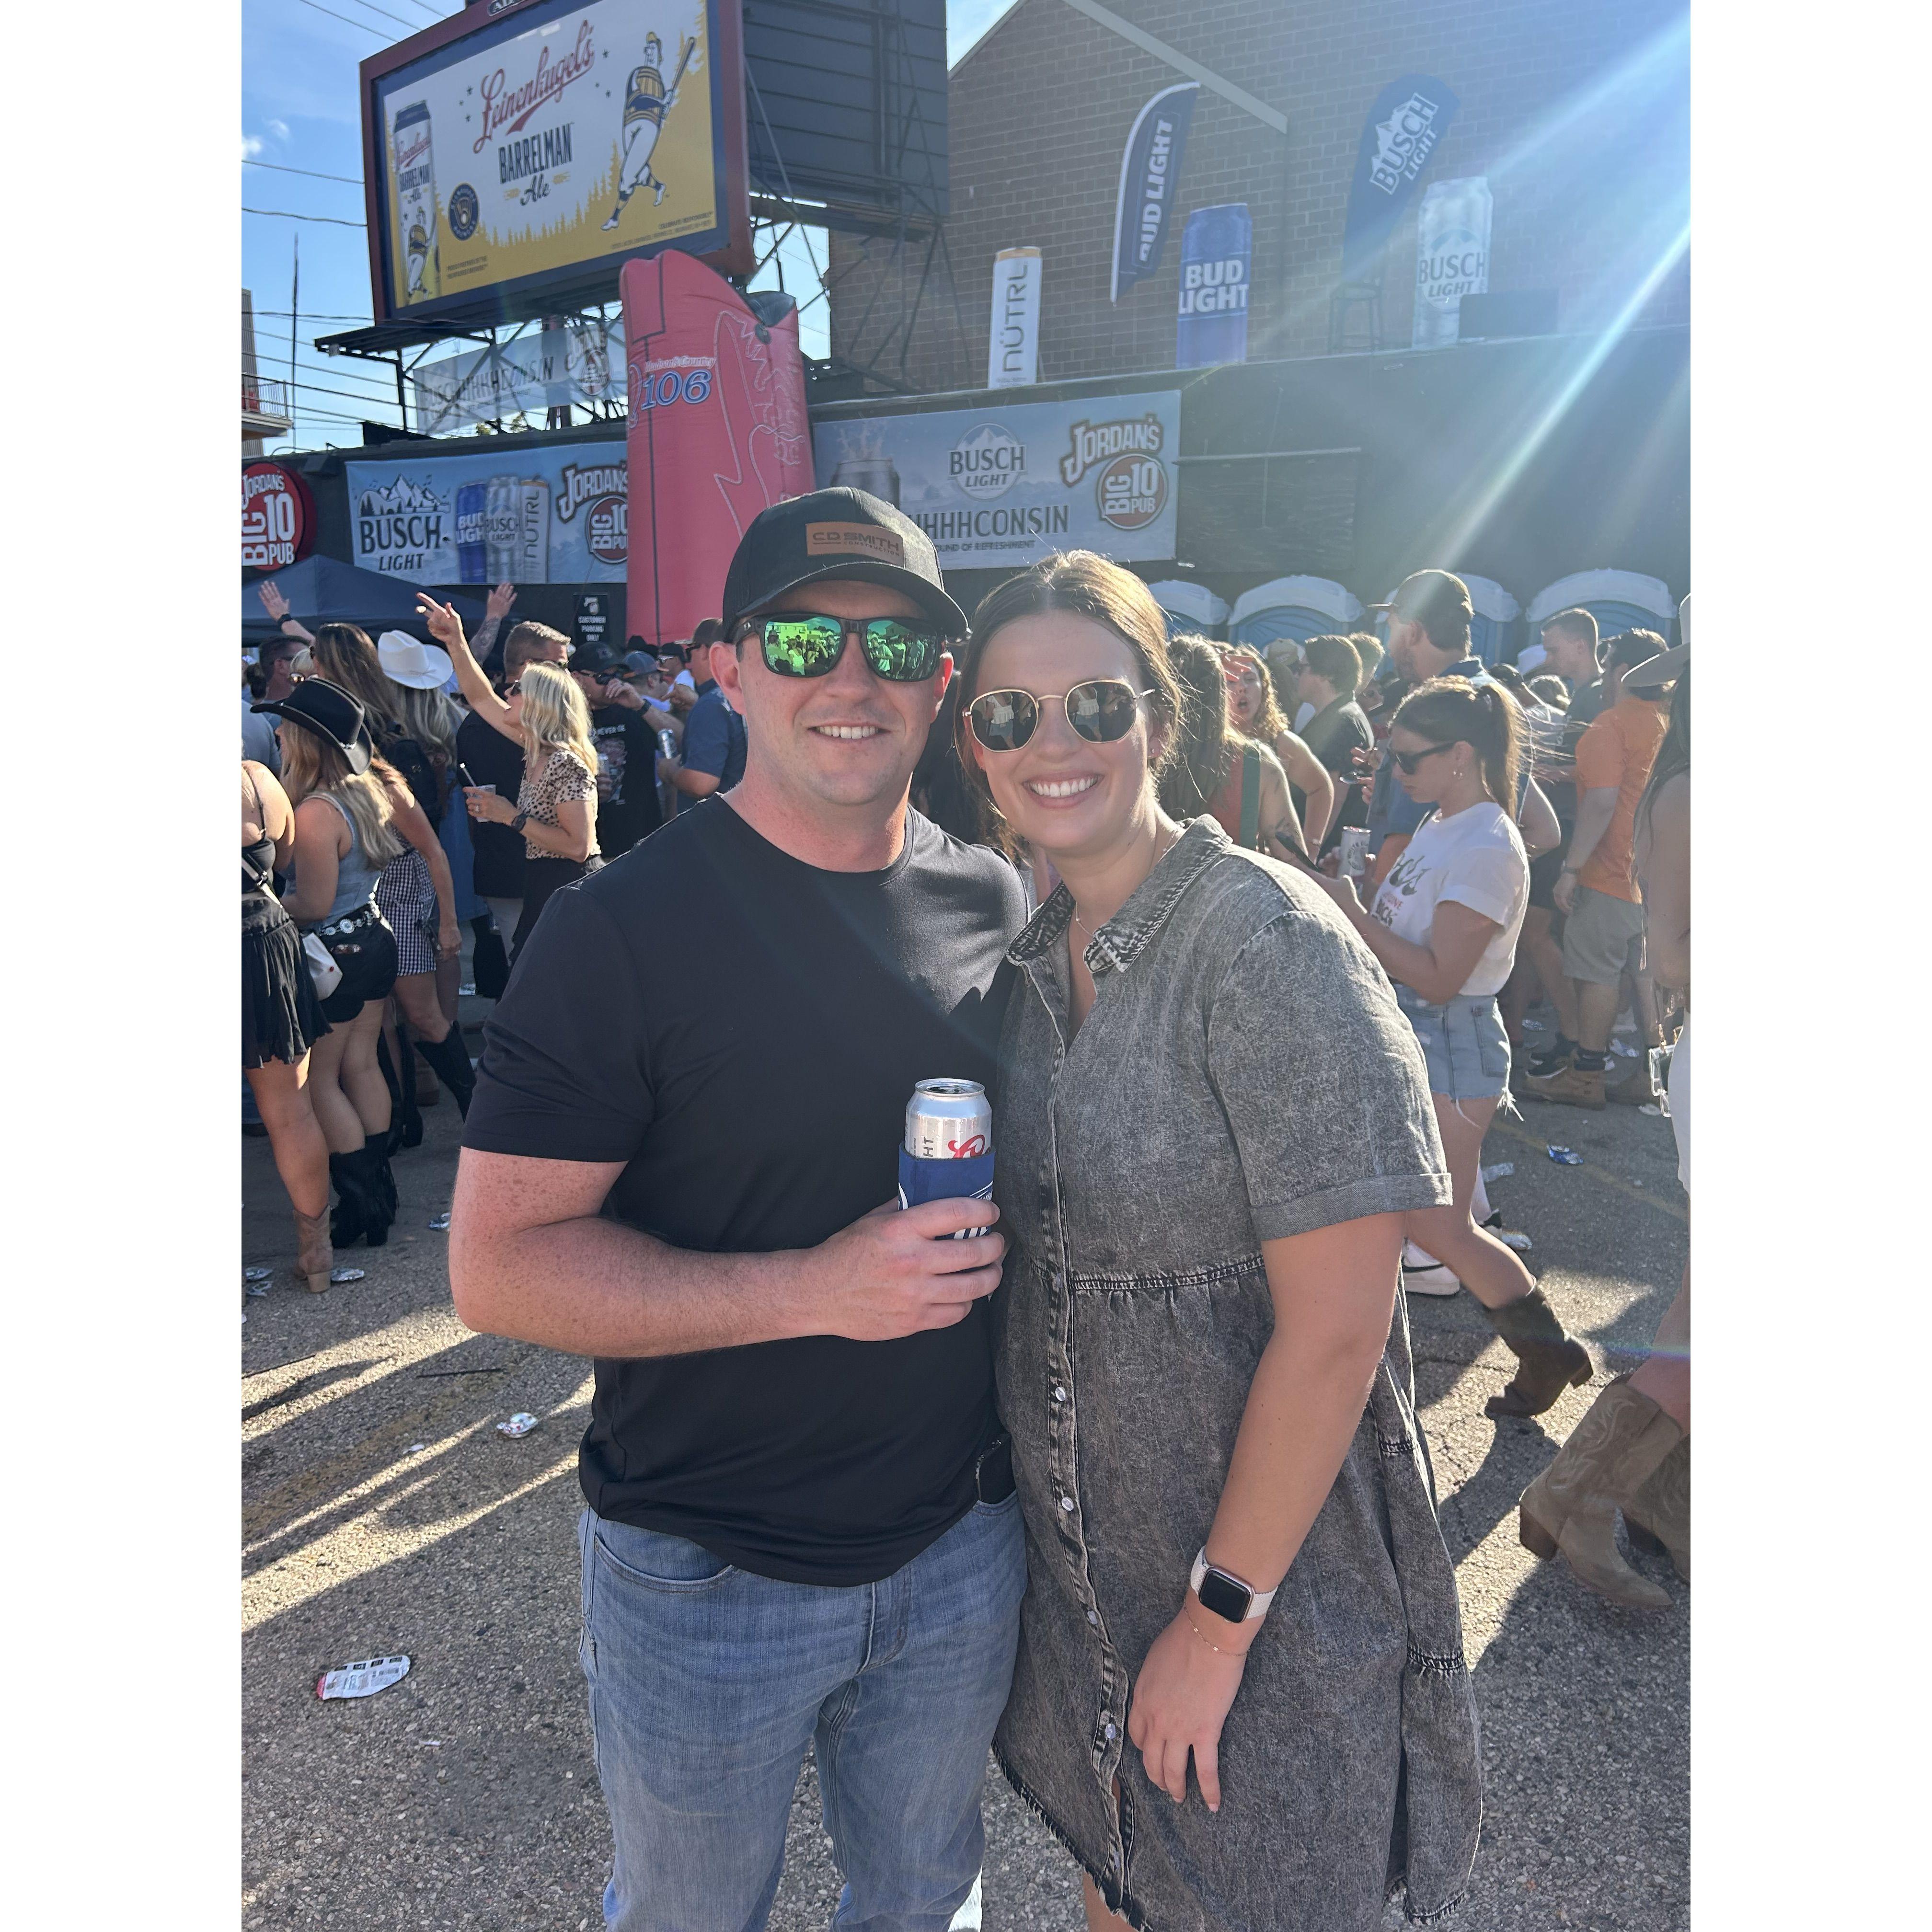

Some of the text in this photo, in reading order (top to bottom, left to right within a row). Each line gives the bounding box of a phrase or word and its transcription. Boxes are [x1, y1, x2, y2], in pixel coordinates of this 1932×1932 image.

[473, 19, 595, 153] Leinenkugel's
[498, 123, 573, 184] BARRELMAN
[1371, 94, 1437, 193] BUSCH
[1403, 129, 1437, 181] LIGHT
[1145, 119, 1173, 200] LIGHT
[520, 173, 551, 206] Ale
[1184, 260, 1244, 289] BUD
[1418, 253, 1486, 284] BUSCH
[1179, 284, 1249, 314] LIGHT
[1428, 281, 1474, 298] LIGHT
[950, 446, 1025, 475] BUSCH
[1064, 418, 1160, 483] JORDAN'S
[242, 470, 285, 510] JORDAN'S
[965, 473, 1010, 487] LIGHT
[1104, 461, 1159, 515] BIG 10
[1131, 497, 1156, 514] PUB
[242, 493, 296, 566] BIG 10
[359, 515, 442, 554] BUSCH
[456, 528, 485, 544] LIGH
[591, 514, 613, 549] BIG
[613, 536, 628, 549] PU
[844, 532, 899, 551] SMITH
[268, 542, 295, 565] PUB
[379, 552, 425, 571] LIGHT
[844, 541, 899, 556] CONSTRUCTION
[935, 543, 959, 552] OUND
[961, 542, 972, 551] OF
